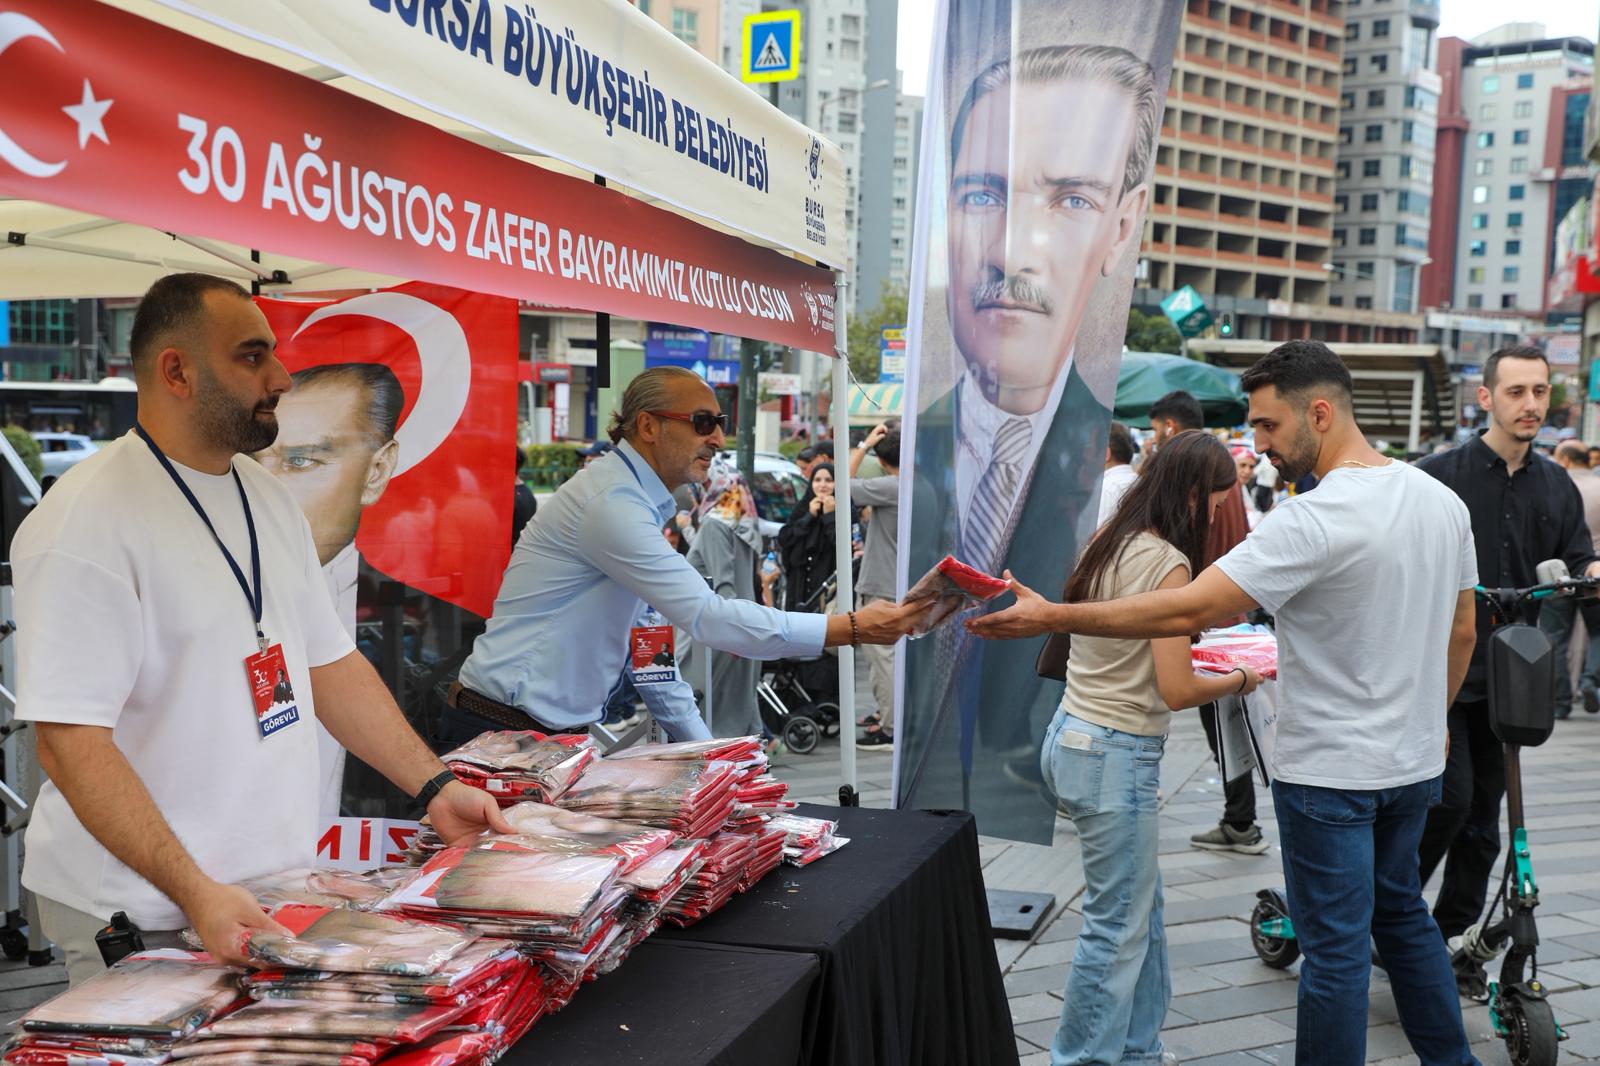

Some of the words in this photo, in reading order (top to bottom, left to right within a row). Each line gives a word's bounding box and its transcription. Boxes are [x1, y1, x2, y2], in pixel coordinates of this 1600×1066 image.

[504, 4, 669, 147] BÜYÜKŞEHİR
[672, 98, 769, 194] BELEDİYESİ
[177, 112, 246, 203] 30
[262, 132, 456, 253] AĞUSTOS
[464, 200, 554, 275] ZAFER
[558, 228, 689, 303] BAYRAMIMIZ
[689, 265, 742, 313] KUTLU
[741, 280, 795, 323] OLSUN
[805, 196, 825, 220] BURSA
[635, 671, 673, 682] GÖREVLİ
[263, 708, 296, 732] GÖREVLİ
